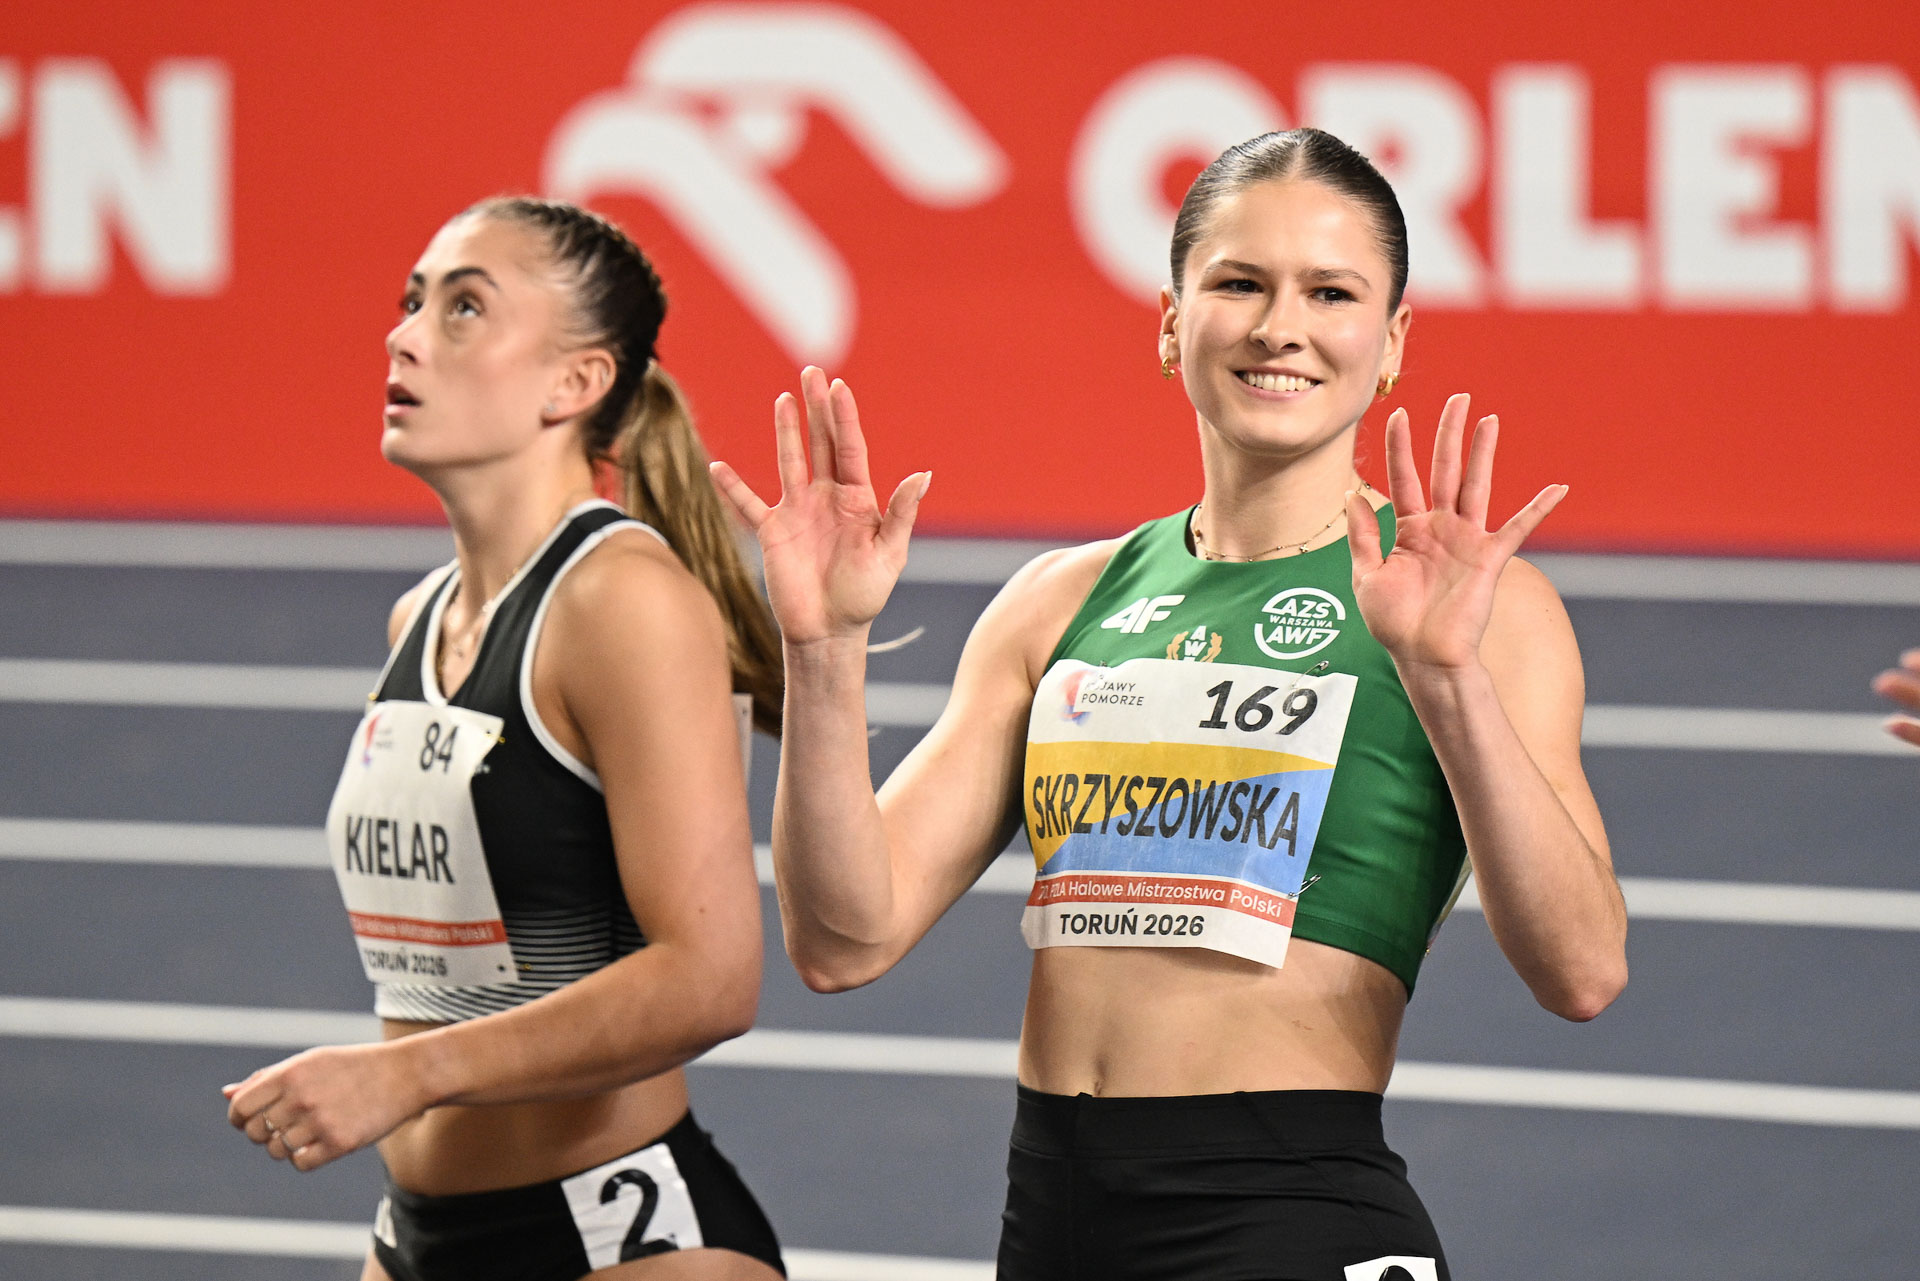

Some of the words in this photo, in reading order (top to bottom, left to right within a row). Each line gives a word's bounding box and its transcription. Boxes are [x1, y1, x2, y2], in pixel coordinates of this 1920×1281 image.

[0, 56, 234, 296] N
[1101, 595, 1186, 634] 4F
[1269, 614, 1333, 629] WARSZAWA
[1272, 598, 1332, 618] AZS
[1184, 625, 1208, 661] AW
[1265, 625, 1325, 645] AWF
[1081, 693, 1145, 706] POMORZE
[1085, 681, 1136, 692] JAWY
[1199, 680, 1319, 736] 169
[420, 721, 459, 774] 84
[1033, 773, 1301, 857] SKRZYSZOWSKA
[345, 814, 455, 885] KIELAR
[1068, 881, 1123, 897] Halowe
[1127, 882, 1226, 901] Mistrzostwa
[1229, 888, 1283, 918] Polski
[1060, 907, 1138, 935] TORUŃ
[1143, 913, 1205, 936] 2026
[600, 1168, 680, 1264] 2
